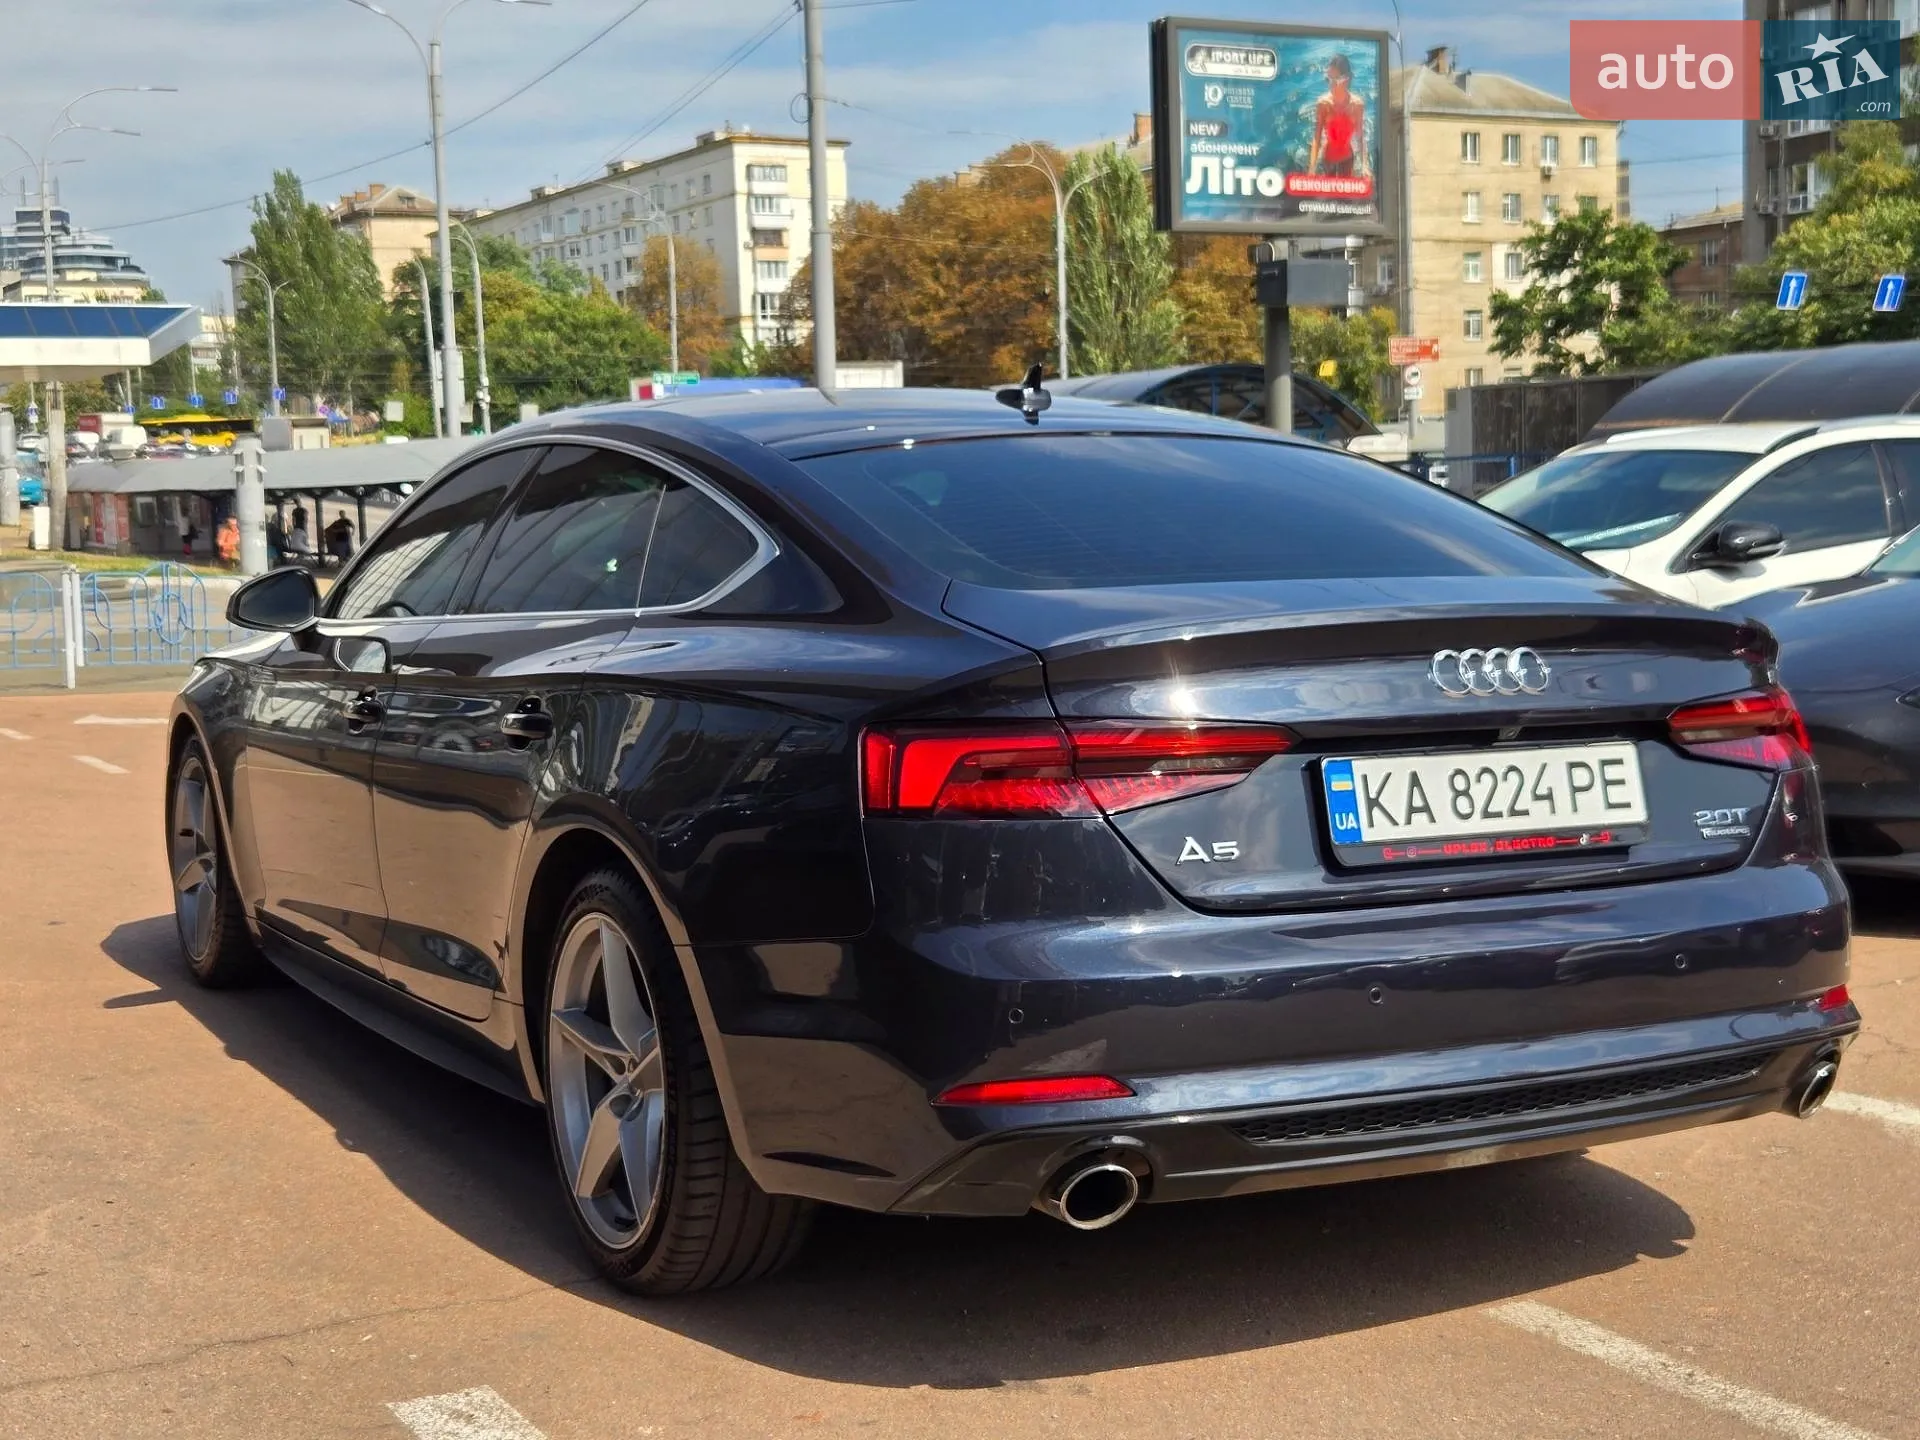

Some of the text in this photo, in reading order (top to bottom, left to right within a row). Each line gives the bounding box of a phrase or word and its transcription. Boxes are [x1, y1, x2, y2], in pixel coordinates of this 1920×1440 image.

[1189, 123, 1220, 136] NEW
[1190, 140, 1260, 156] абонемент
[1185, 155, 1285, 197] Літо
[1289, 178, 1367, 194] БЕЗКОШТОВНО
[1361, 757, 1632, 828] KA 8224 PE
[1335, 812, 1358, 830] UA
[1175, 836, 1240, 865] A5
